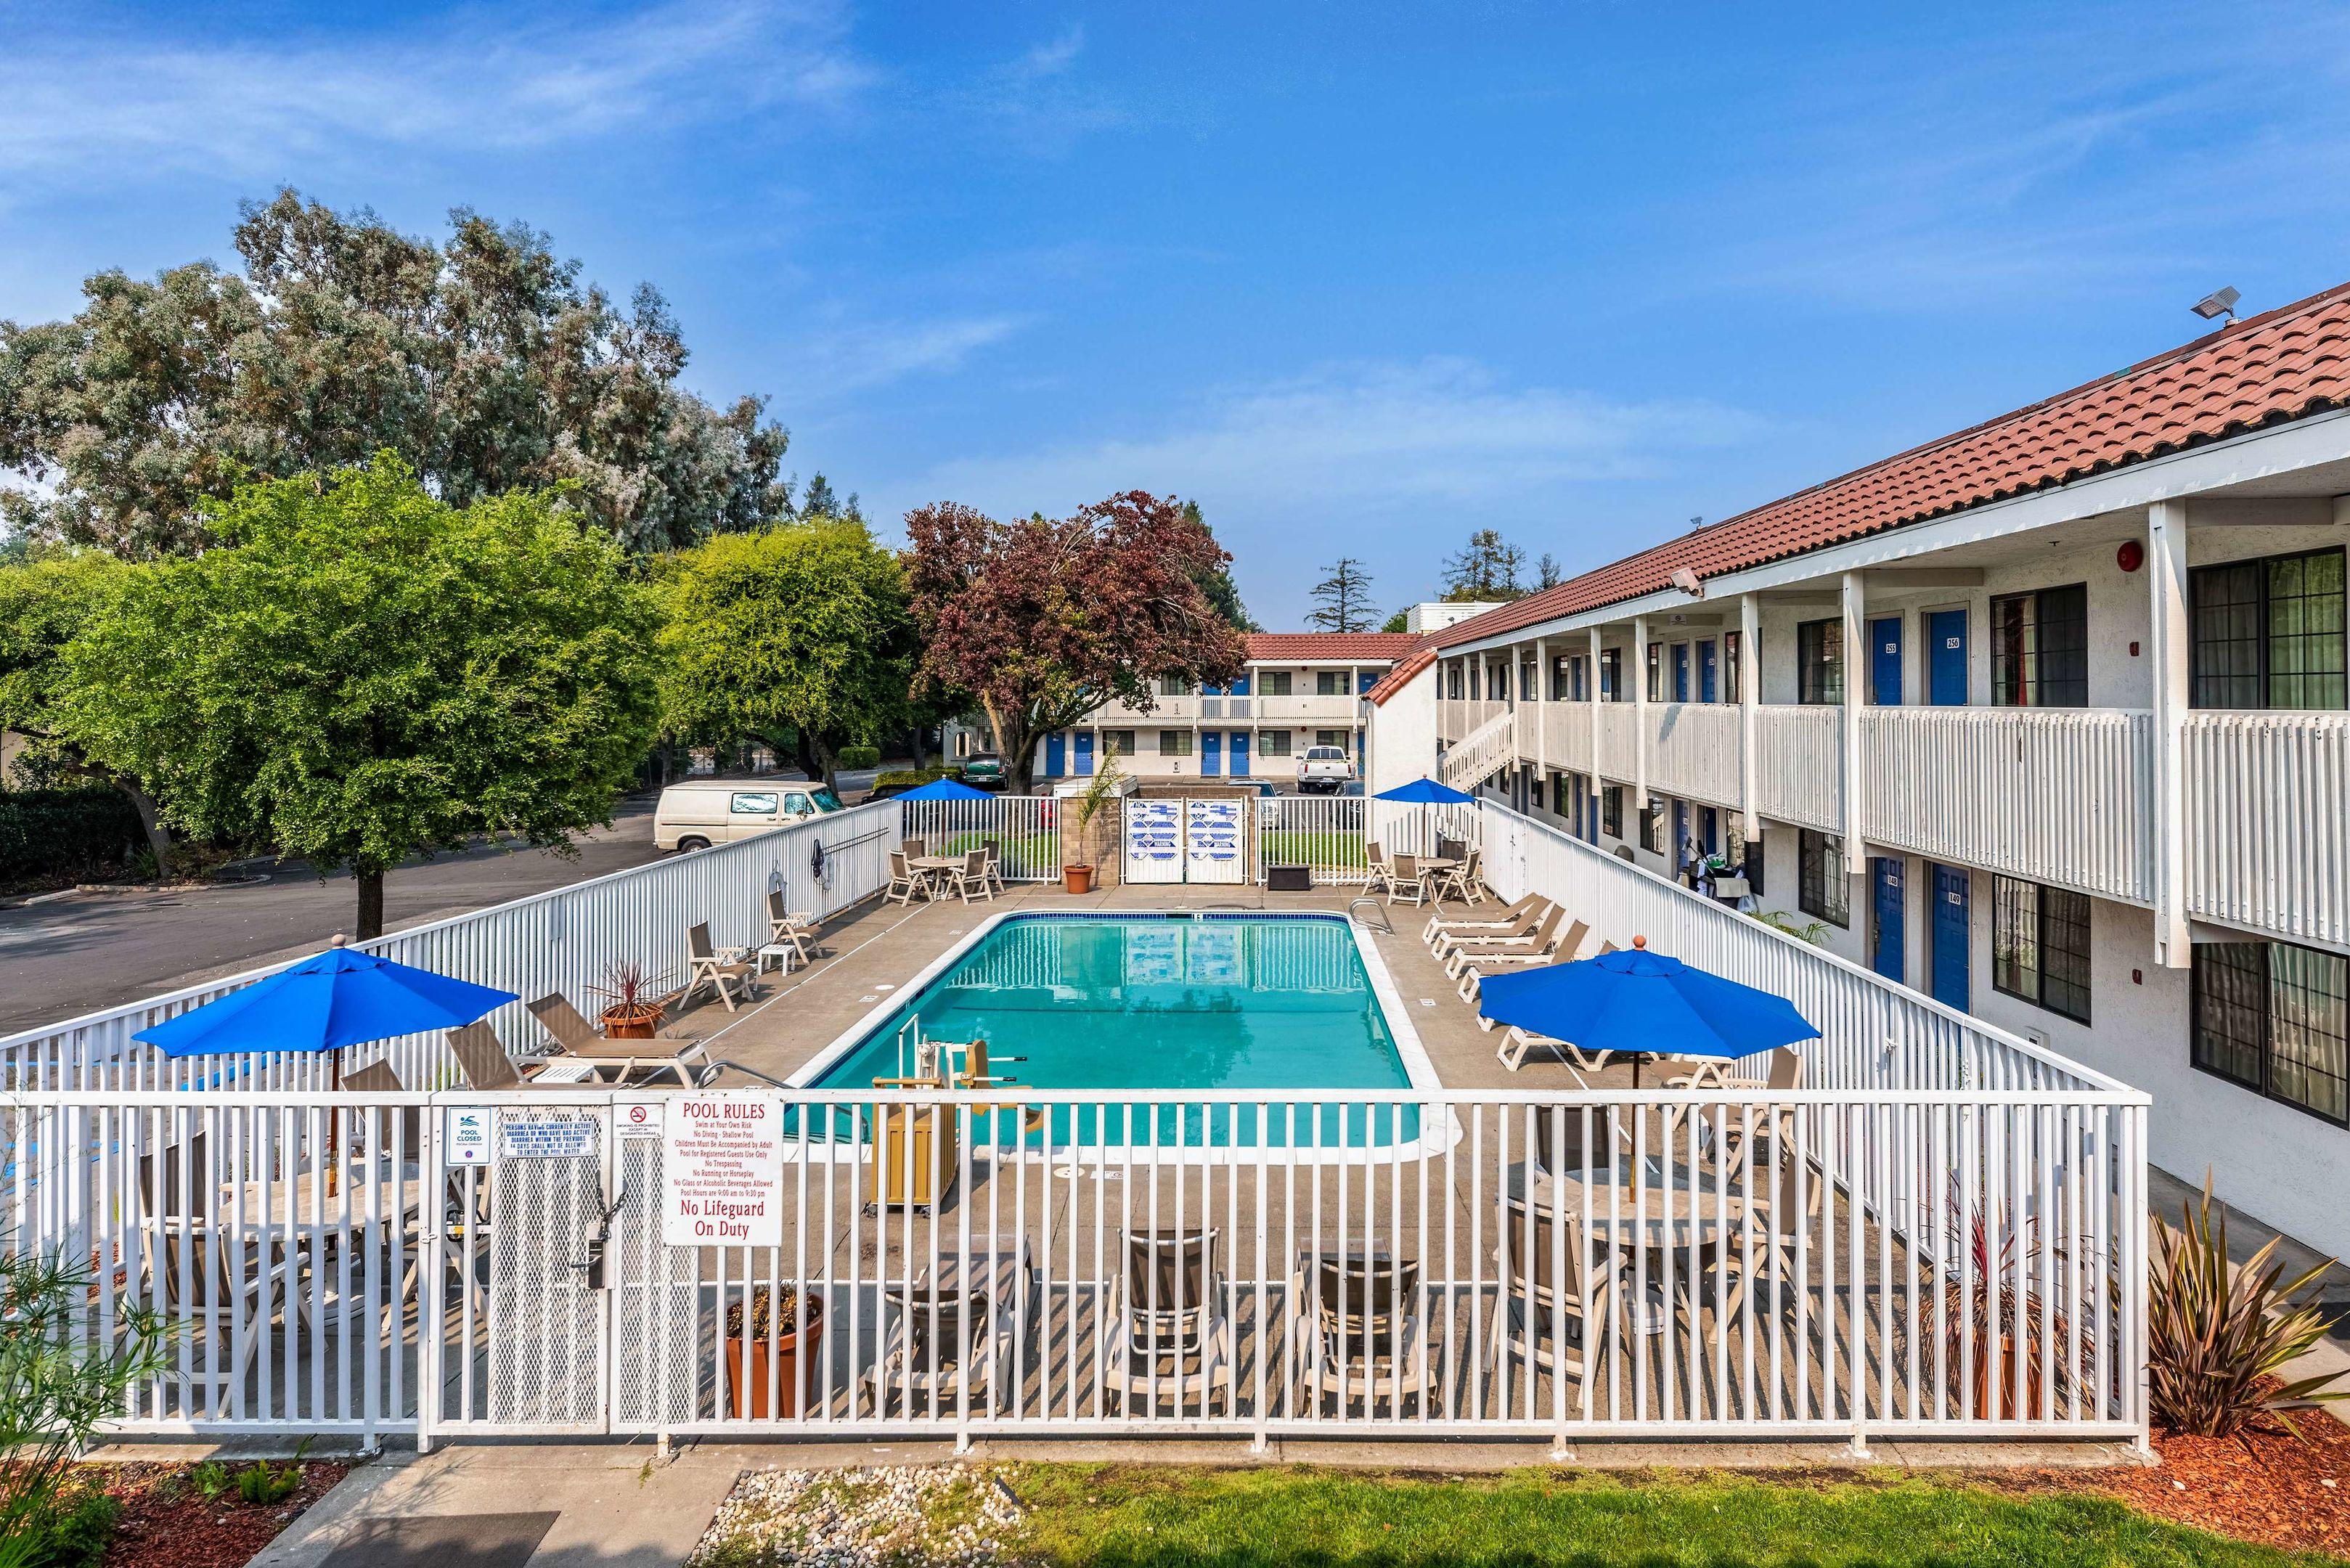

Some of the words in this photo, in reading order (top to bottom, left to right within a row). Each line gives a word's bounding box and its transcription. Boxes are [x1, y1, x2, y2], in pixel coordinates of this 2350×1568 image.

[1950, 894, 1959, 903] 149
[683, 1103, 719, 1118] POOL
[724, 1103, 764, 1119] RULES
[718, 1140, 750, 1149] Accompanied
[751, 1141, 757, 1150] by
[714, 1160, 742, 1169] Trespassing
[701, 1169, 722, 1178] Running
[727, 1180, 751, 1188] Beverages
[681, 1200, 698, 1215] No
[704, 1200, 764, 1220] Lifeguard
[695, 1220, 714, 1236] On
[719, 1221, 749, 1240] Duty
